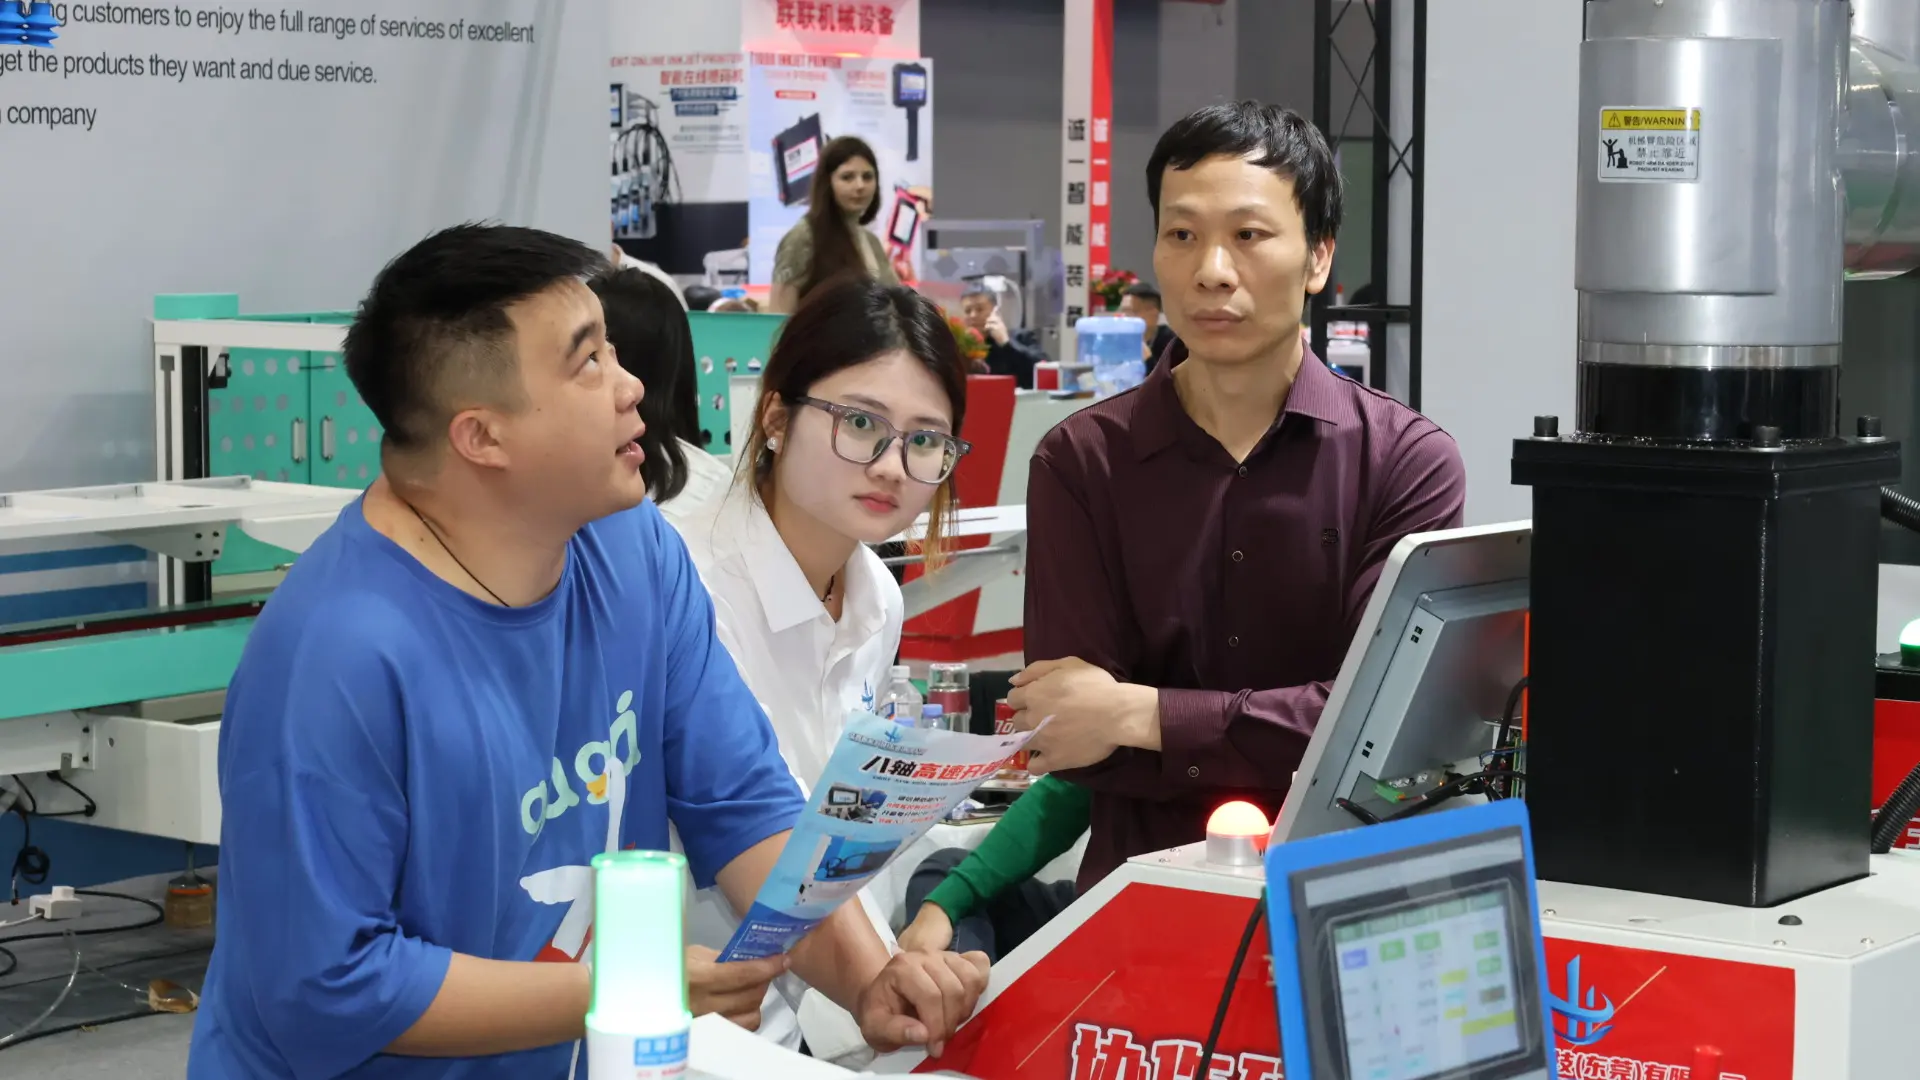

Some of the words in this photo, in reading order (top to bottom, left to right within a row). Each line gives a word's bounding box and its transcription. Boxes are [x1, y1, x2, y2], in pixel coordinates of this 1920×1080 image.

[72, 2, 170, 26] customers
[174, 6, 192, 27] to
[196, 6, 244, 35] enjoy
[249, 8, 276, 32] the
[280, 9, 303, 33] full
[308, 15, 356, 40] range
[360, 14, 377, 36] of
[380, 16, 445, 39] services
[449, 18, 464, 40] of
[467, 22, 535, 43] excellent
[28, 49, 58, 73] the
[64, 52, 144, 79] products
[149, 53, 188, 83] they
[193, 58, 236, 79] want
[240, 58, 273, 80] and
[278, 59, 310, 81] due
[314, 61, 378, 84] service.
[7, 105, 97, 131] company
